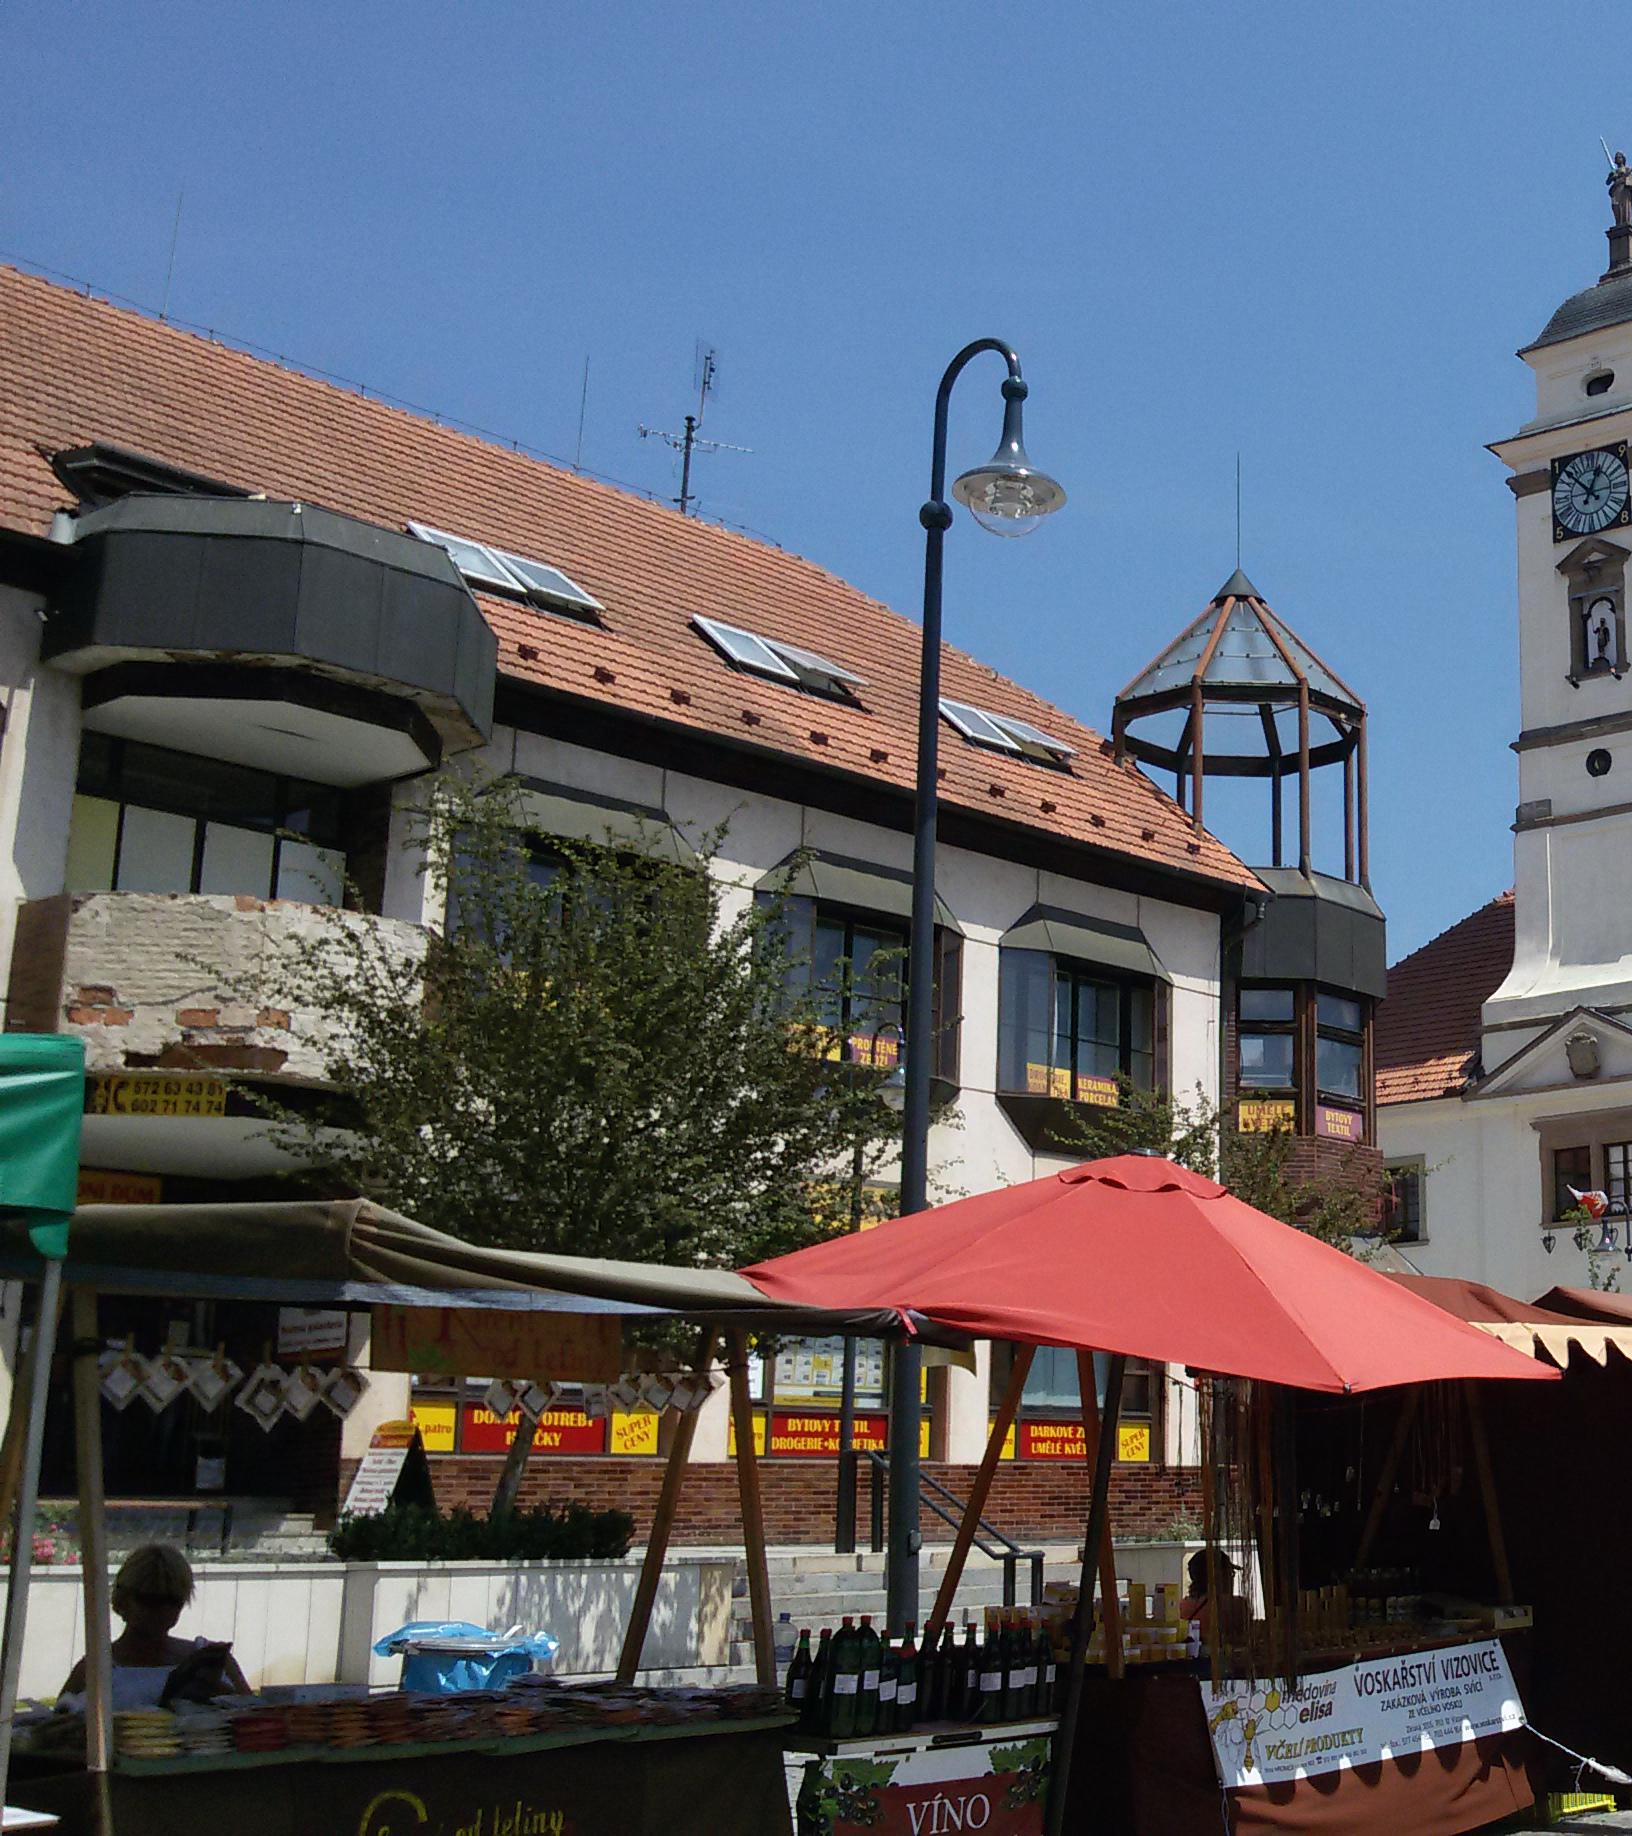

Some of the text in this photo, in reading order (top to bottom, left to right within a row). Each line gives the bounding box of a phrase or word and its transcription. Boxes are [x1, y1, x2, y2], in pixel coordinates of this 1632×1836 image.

[1618, 445, 1626, 457] 9
[1556, 510, 1629, 539] 5 8
[1354, 1650, 1500, 1697] VOSKAŘSTVÍ VIZOVICE
[1299, 1700, 1333, 1724] elisa
[1380, 1689, 1428, 1712] ZAKÁZKOVÁ
[1429, 1685, 1462, 1702] VÝROBA
[1408, 1709, 1417, 1719] ZE
[1442, 1700, 1463, 1711] VOSKU
[1304, 1727, 1364, 1756] PRODUKTY
[906, 1792, 991, 1836] VÍNO
